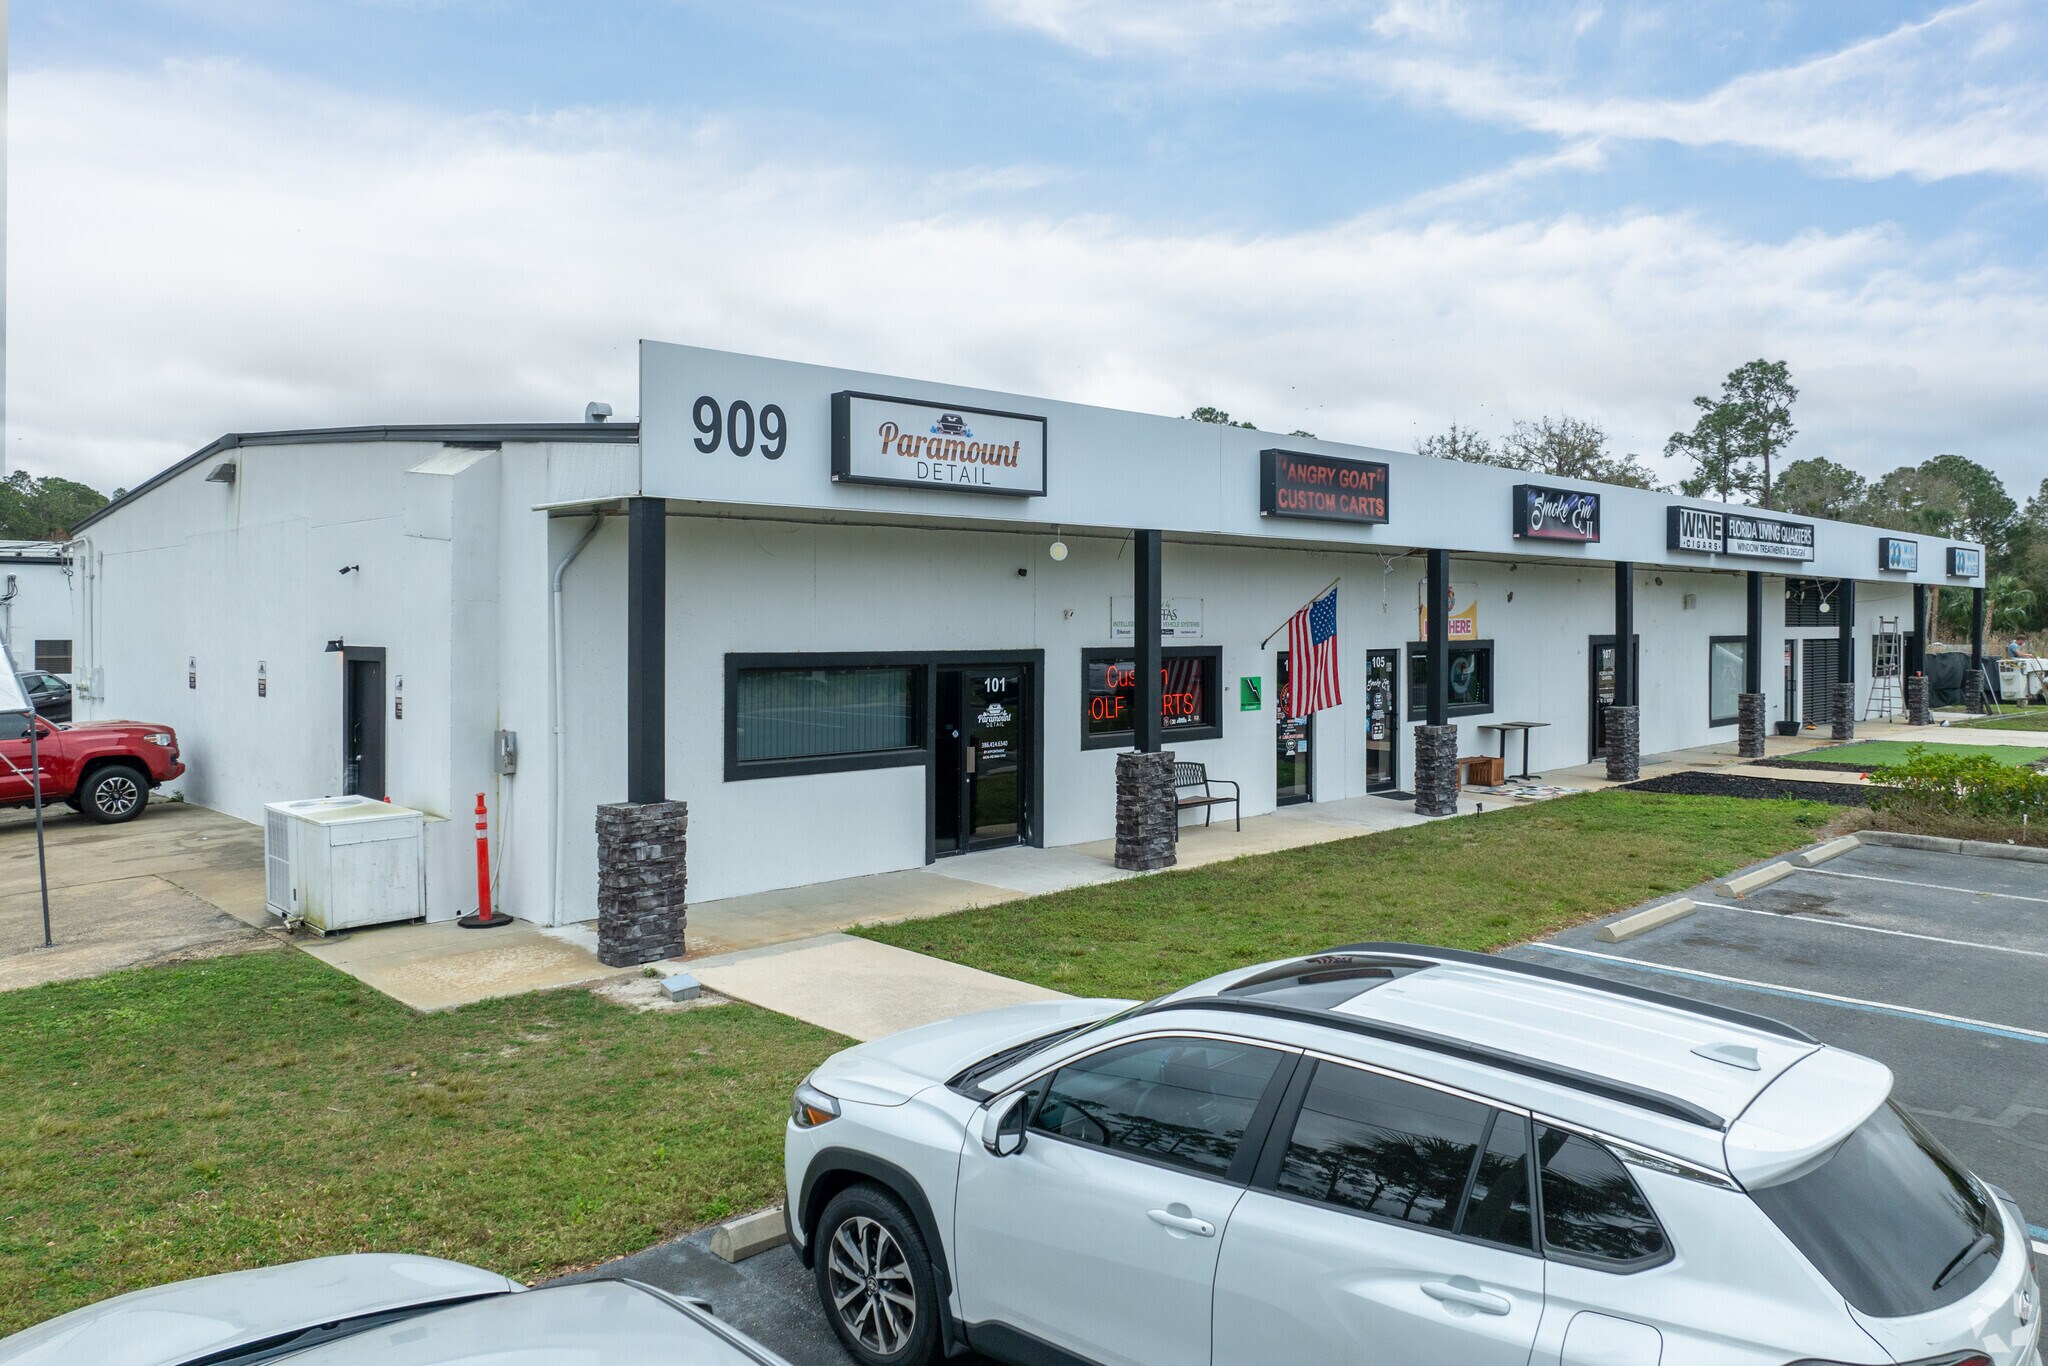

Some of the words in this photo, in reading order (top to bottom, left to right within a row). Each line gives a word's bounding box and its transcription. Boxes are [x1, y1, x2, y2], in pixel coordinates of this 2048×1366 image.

[692, 395, 788, 461] 909
[879, 421, 1021, 468] Paramount
[917, 460, 992, 485] DETAIL
[1278, 488, 1336, 512] CUSTOM
[1340, 495, 1385, 517] CARTS
[1531, 492, 1571, 531] Smoke
[1572, 498, 1593, 535] Em
[1681, 511, 1722, 541] WINE
[1729, 519, 1757, 539] FLORIDA
[1758, 523, 1781, 541] LIVING
[1781, 527, 1812, 544] QUARTERS
[1736, 542, 1759, 552] WINDOW
[1760, 544, 1786, 556] TREATMENTS
[1790, 548, 1806, 557] DESIGN
[1448, 619, 1471, 634] HERE
[1371, 656, 1385, 668] 105
[984, 677, 1006, 693] 101
[1088, 697, 1124, 720] OLF
[1161, 693, 1194, 716] RTS
[977, 713, 1012, 723] Paramount
